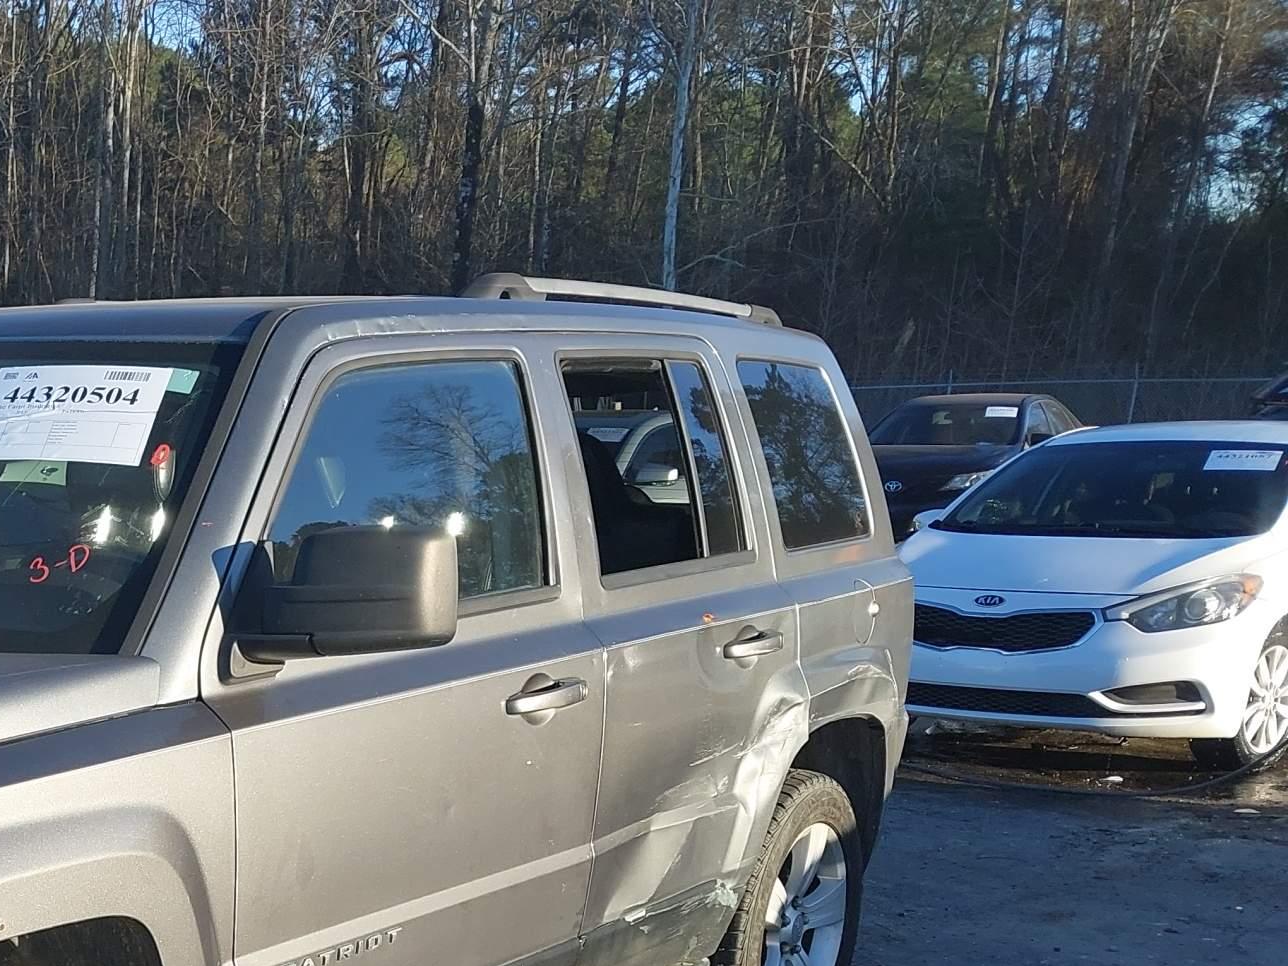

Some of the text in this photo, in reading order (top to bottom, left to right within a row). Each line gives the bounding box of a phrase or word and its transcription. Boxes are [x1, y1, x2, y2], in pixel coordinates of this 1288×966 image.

[3, 386, 140, 405] 44320504
[30, 544, 91, 582] 3-D
[978, 596, 1000, 604] KIA
